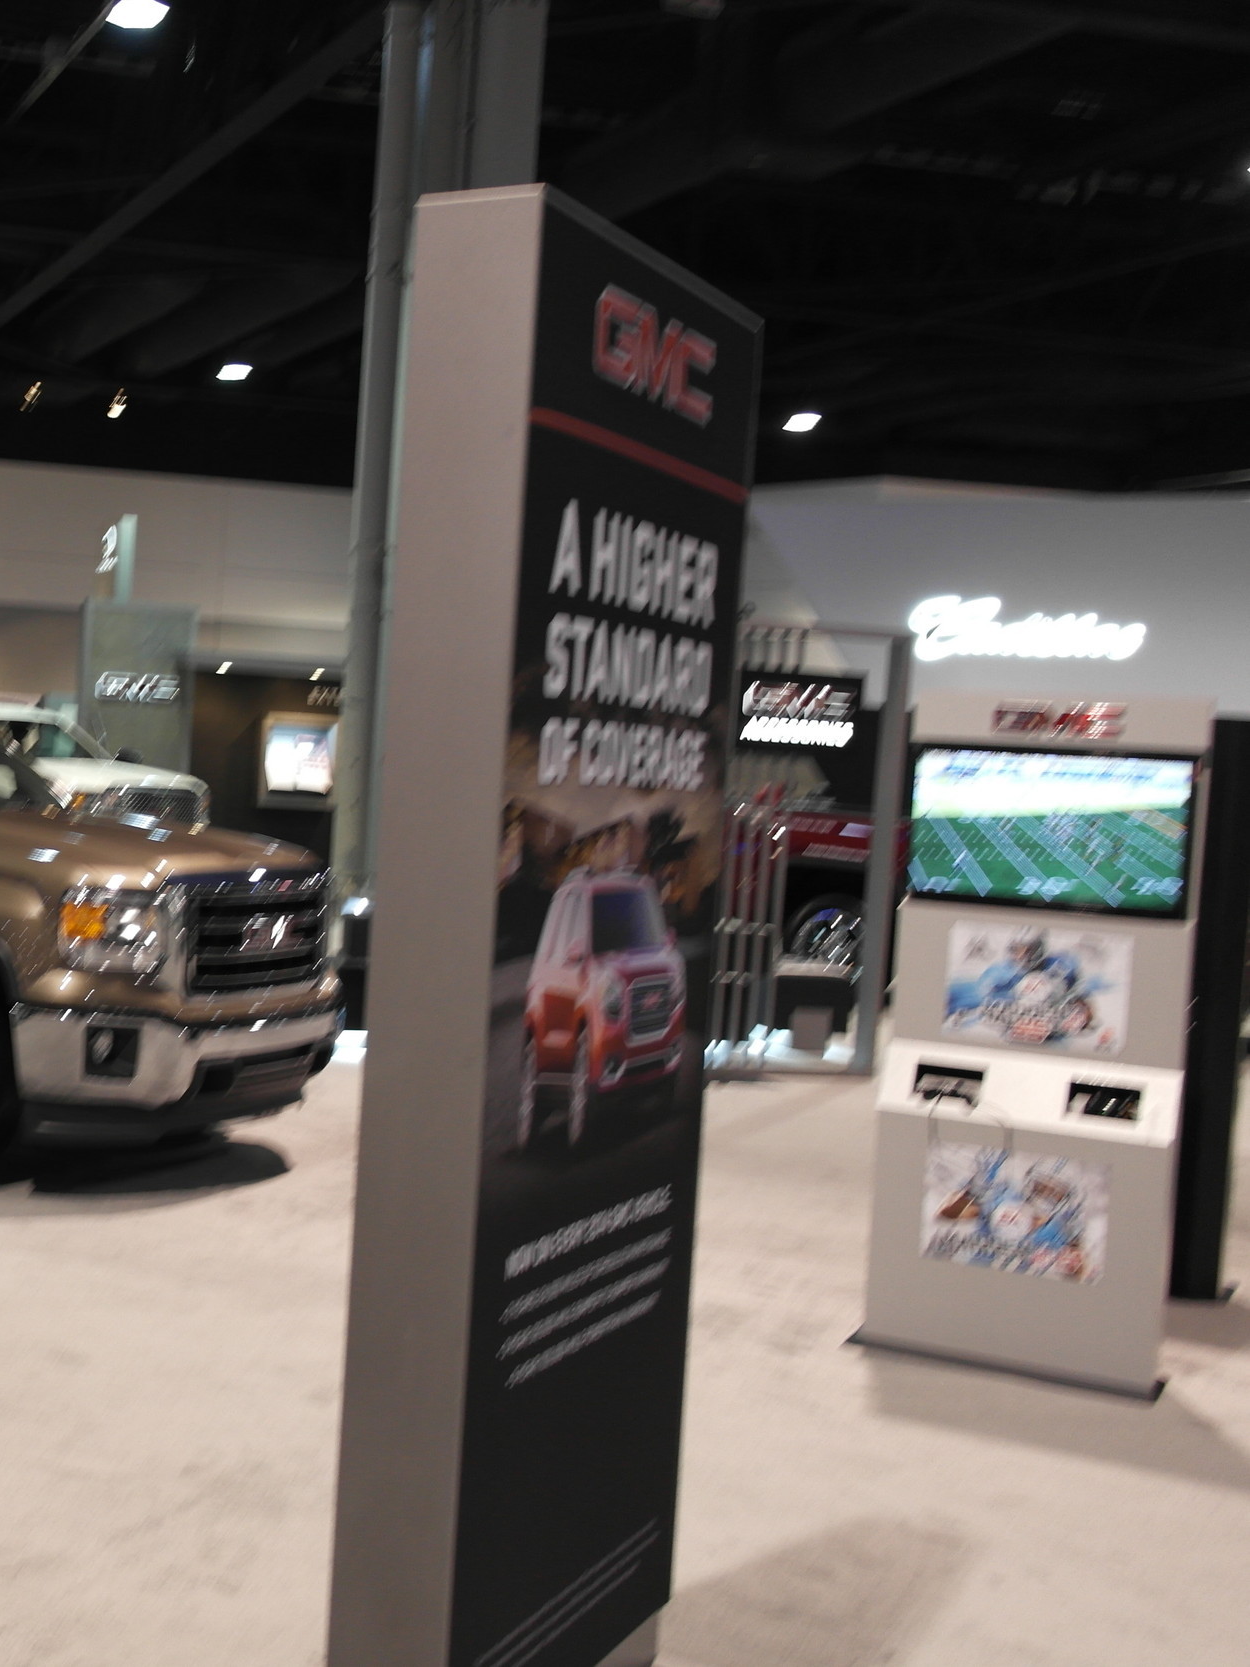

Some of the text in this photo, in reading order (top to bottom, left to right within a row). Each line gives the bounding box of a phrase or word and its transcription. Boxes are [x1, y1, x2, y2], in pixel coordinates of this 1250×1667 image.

[592, 282, 717, 428] GMC
[548, 498, 719, 630] A HIGHER
[543, 612, 714, 718] STANDARD
[537, 716, 707, 792] OF COVERAGE
